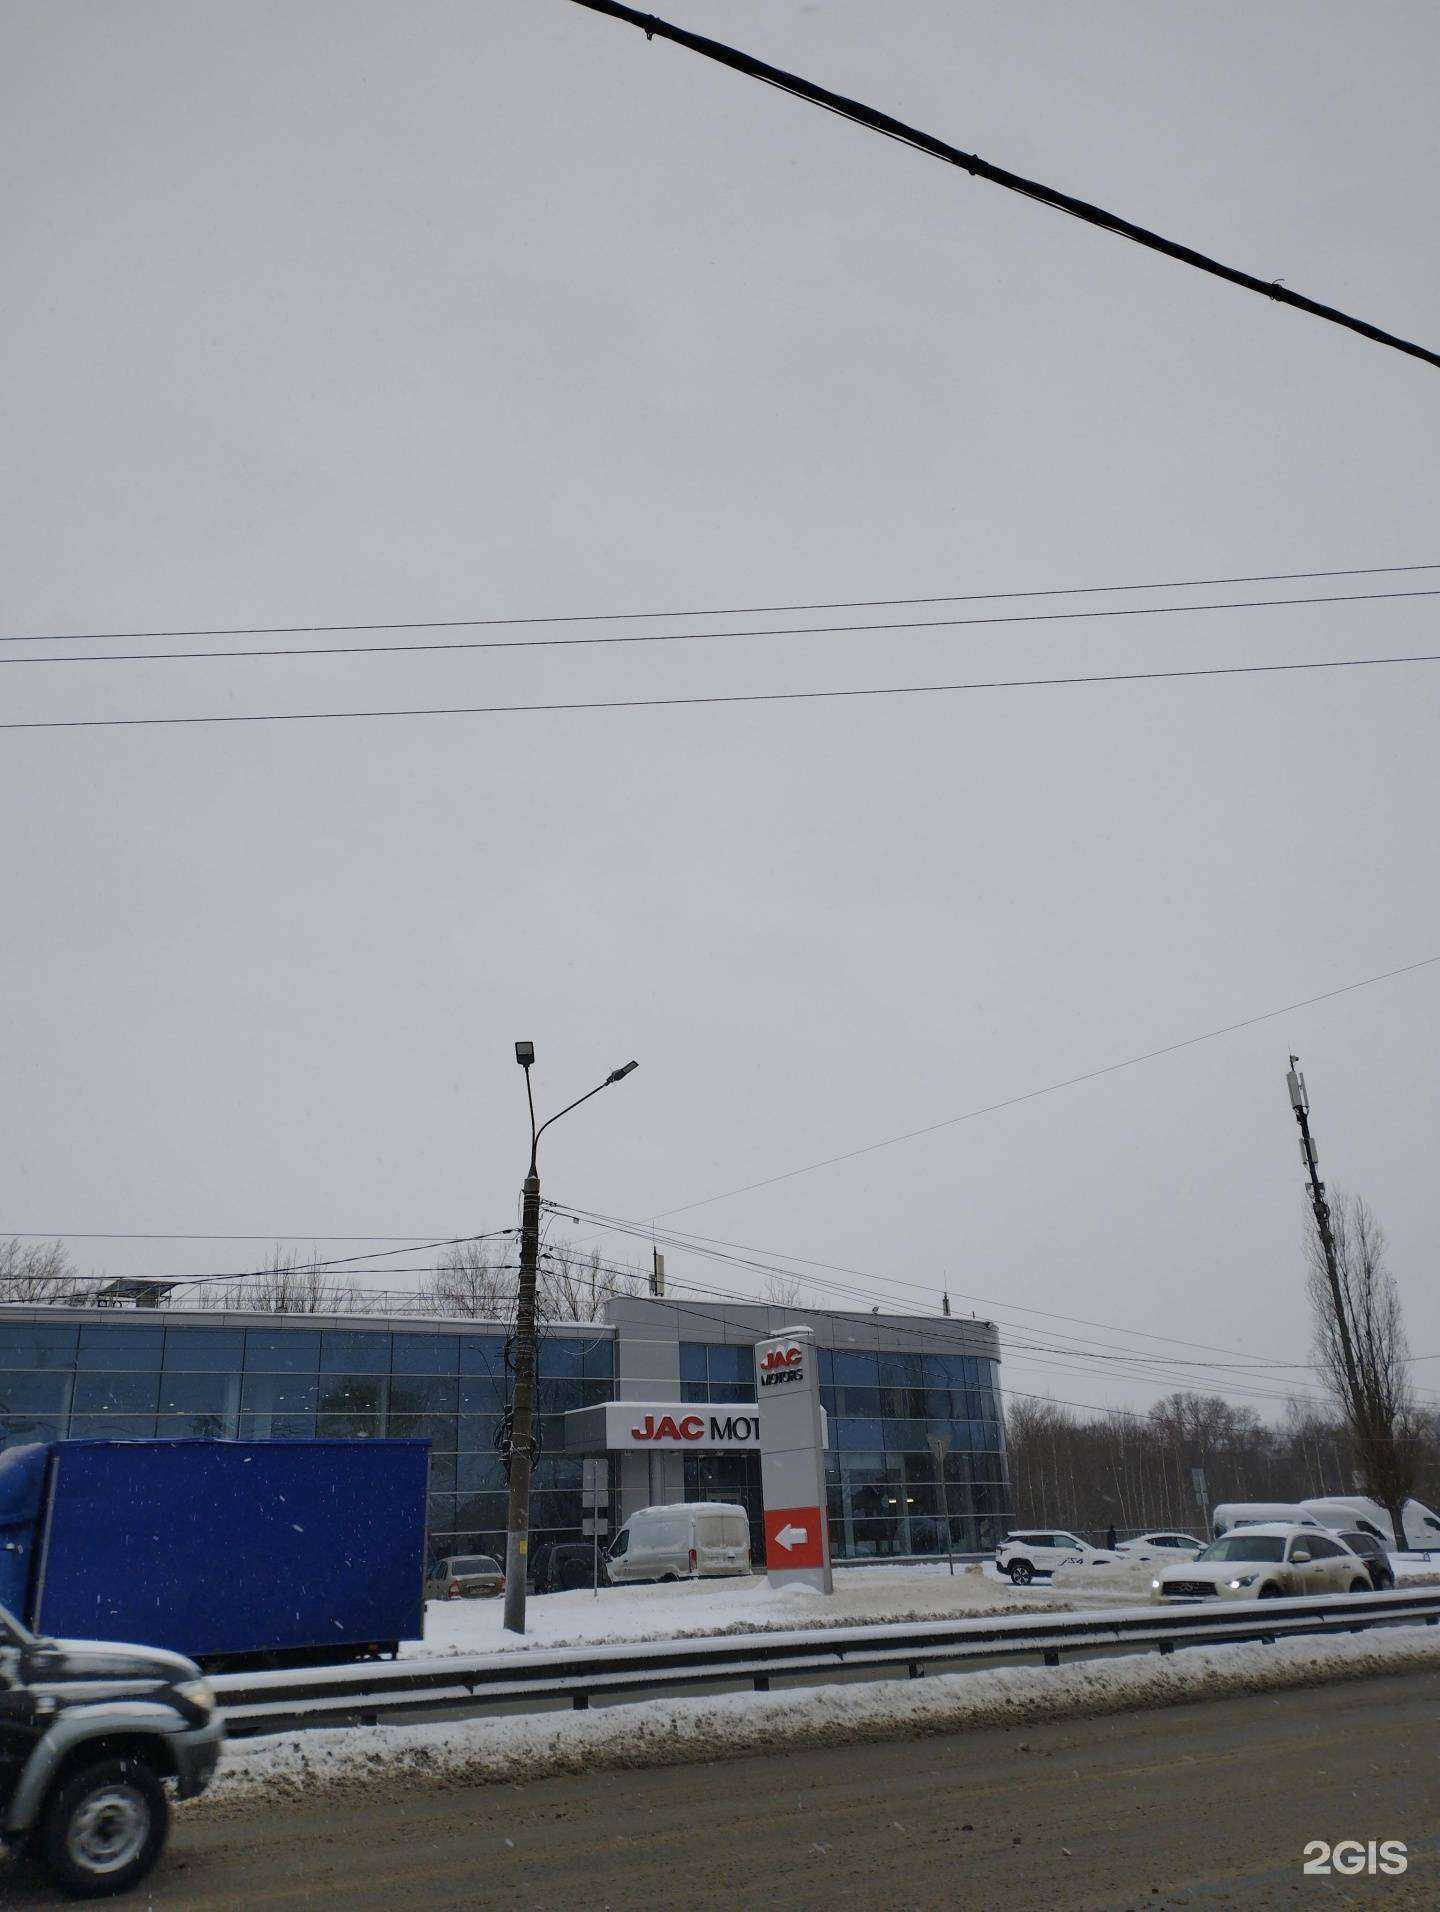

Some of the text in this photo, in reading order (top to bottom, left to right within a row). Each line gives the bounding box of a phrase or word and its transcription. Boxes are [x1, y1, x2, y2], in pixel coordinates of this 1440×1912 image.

[760, 1347, 802, 1370] JAC
[761, 1368, 803, 1386] MOTORS
[631, 1416, 704, 1440] JAC
